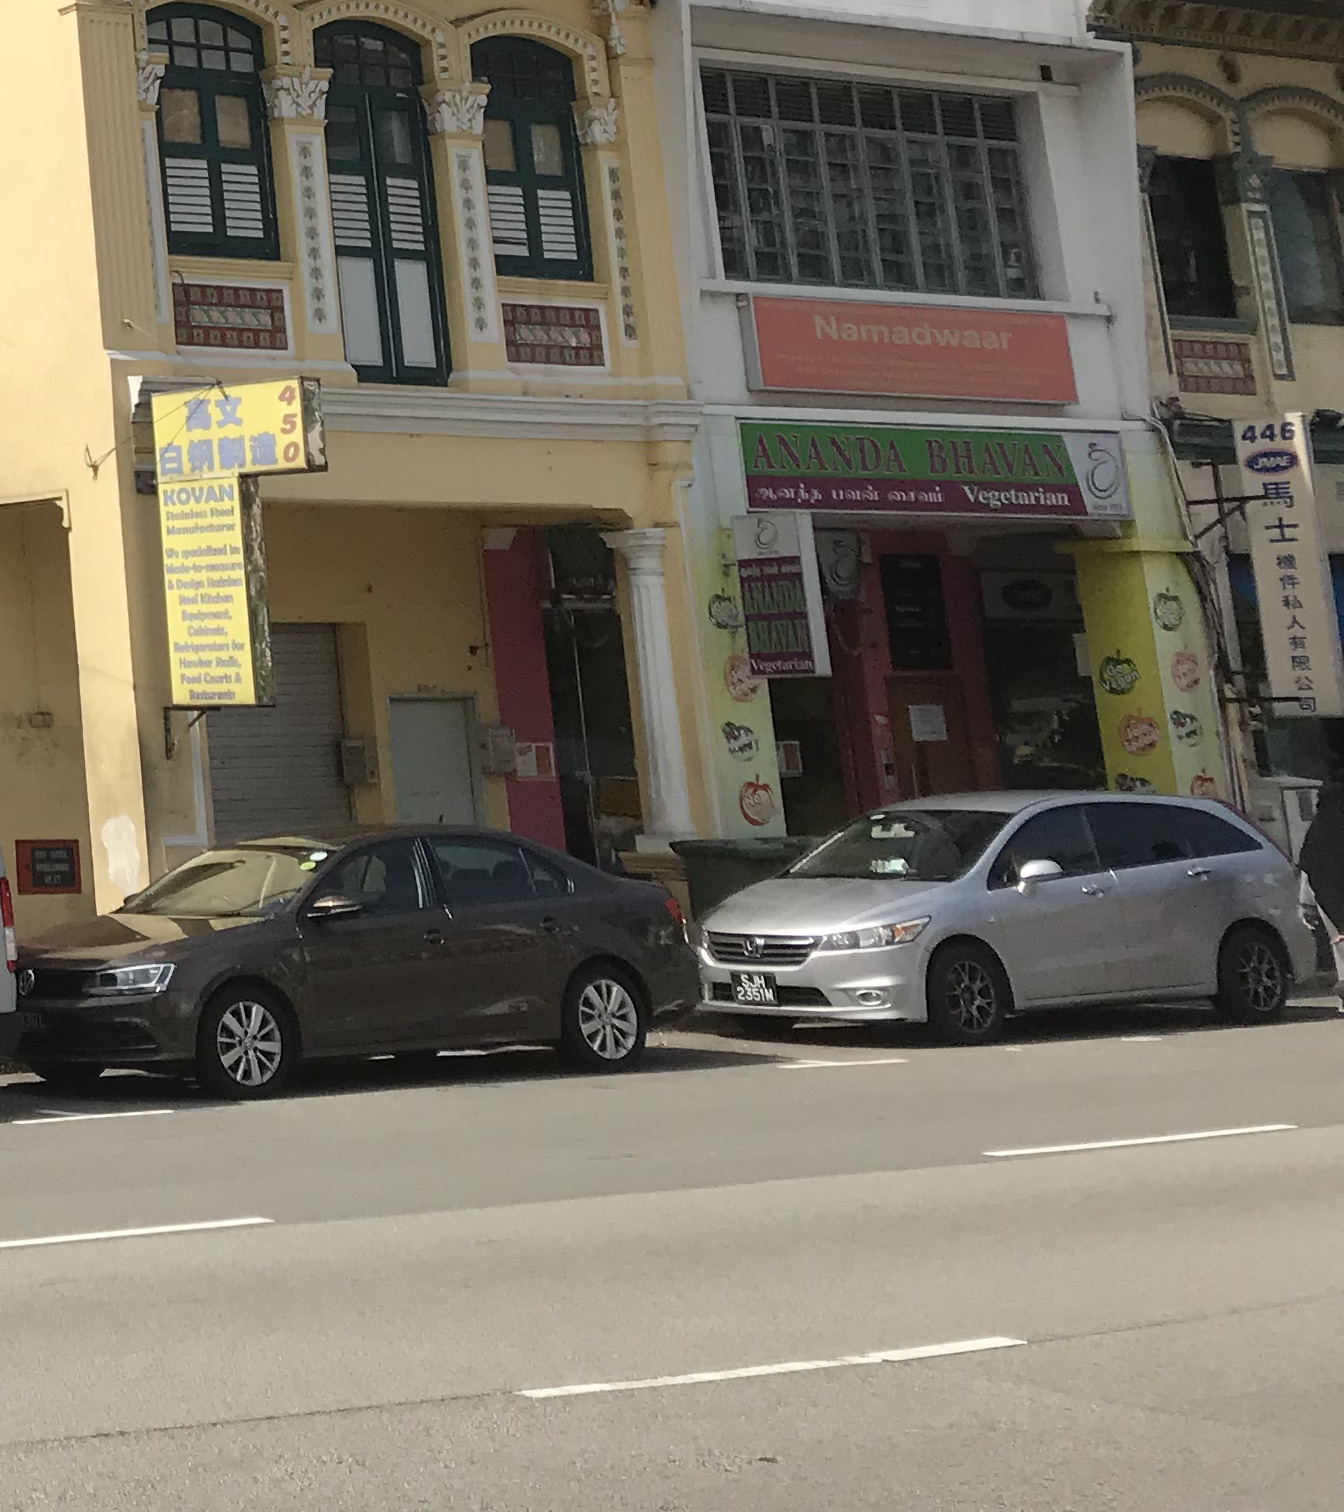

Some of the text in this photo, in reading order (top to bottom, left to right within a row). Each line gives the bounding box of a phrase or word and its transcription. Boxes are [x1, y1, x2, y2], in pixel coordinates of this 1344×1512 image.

[814, 314, 1013, 350] Namadwaar
[1241, 420, 1296, 444] 446
[752, 433, 1068, 479] ANANDA BHAVAN
[163, 484, 234, 506] KOVAN
[961, 484, 1071, 507] Vegetarian
[750, 657, 814, 673] Vegetarian
[740, 973, 766, 988] SJH
[736, 986, 775, 1002] 2351M
